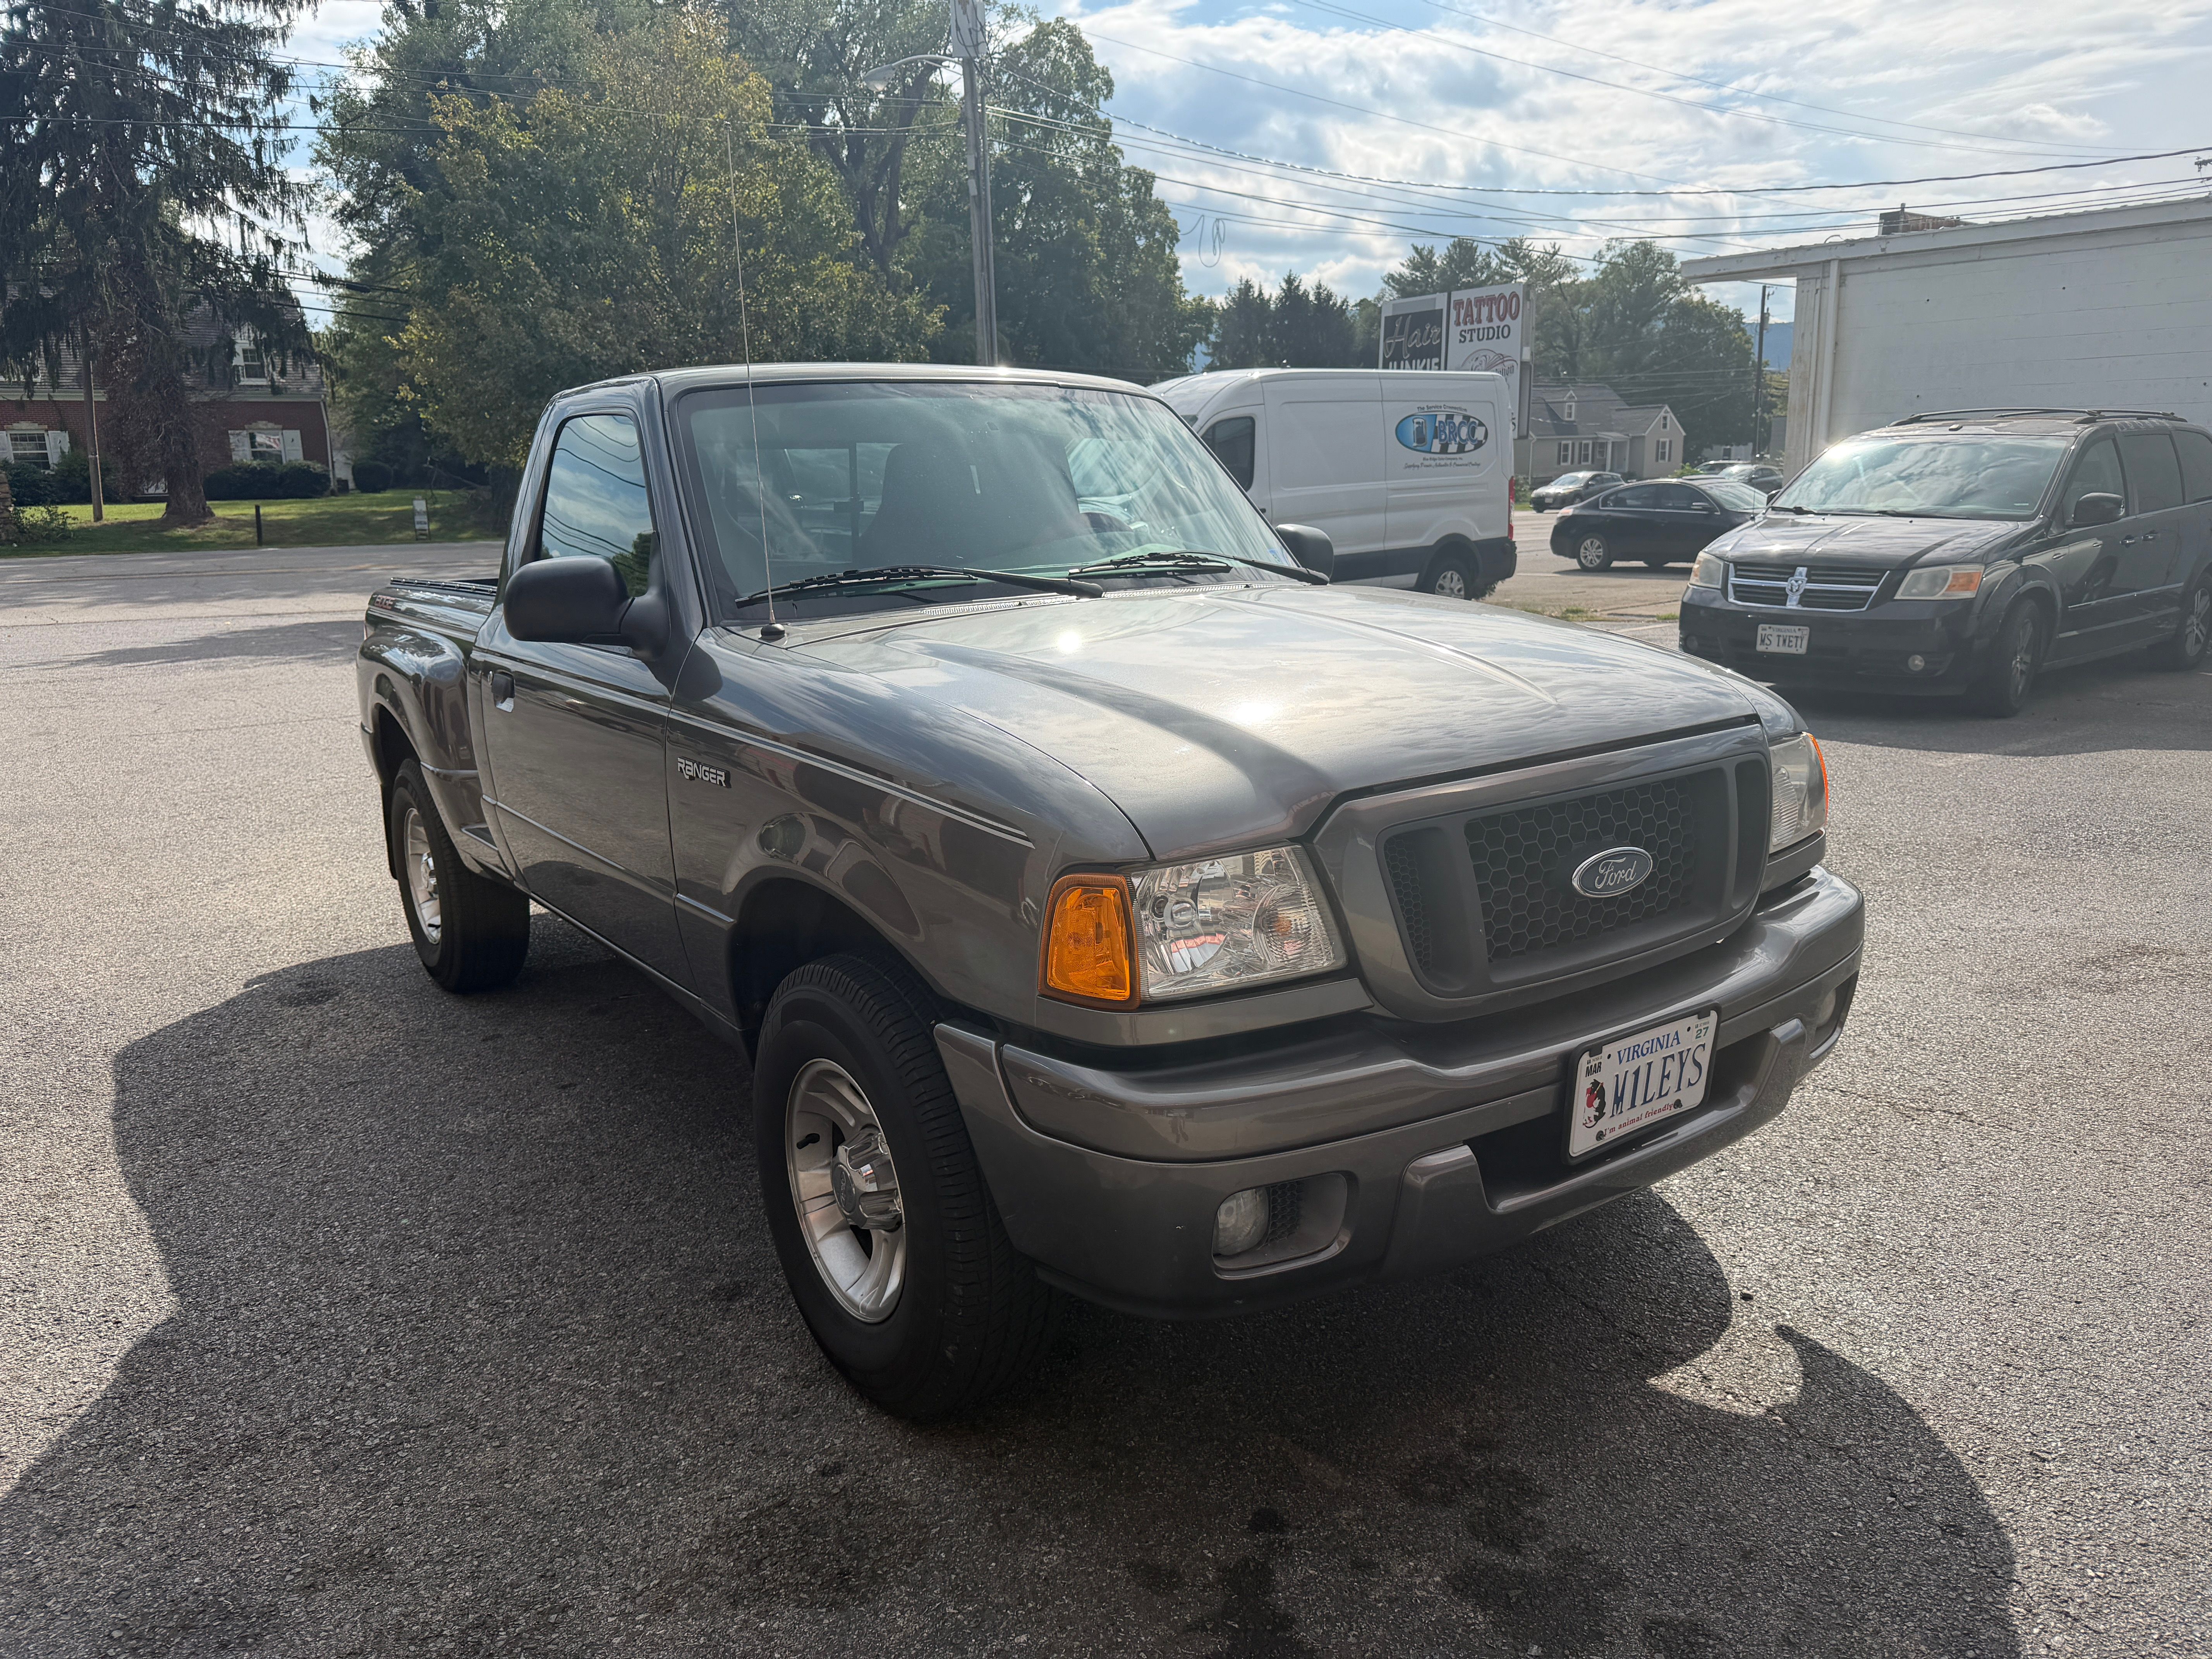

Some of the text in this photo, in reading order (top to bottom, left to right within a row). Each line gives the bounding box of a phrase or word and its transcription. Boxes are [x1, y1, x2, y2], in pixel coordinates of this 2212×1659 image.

[1453, 291, 1520, 326] TATTOO
[1383, 314, 1441, 359] Hair
[1459, 324, 1511, 344] STUDIO
[1437, 420, 1478, 445] BRCC
[374, 595, 397, 610] EDGE
[1595, 857, 1637, 889] Ford
[1695, 1026, 1709, 1039] 27
[1617, 1030, 1681, 1065] VIRGINIA
[1585, 1061, 1602, 1077] MAR
[1604, 1103, 1673, 1137] I'm animal friendly
